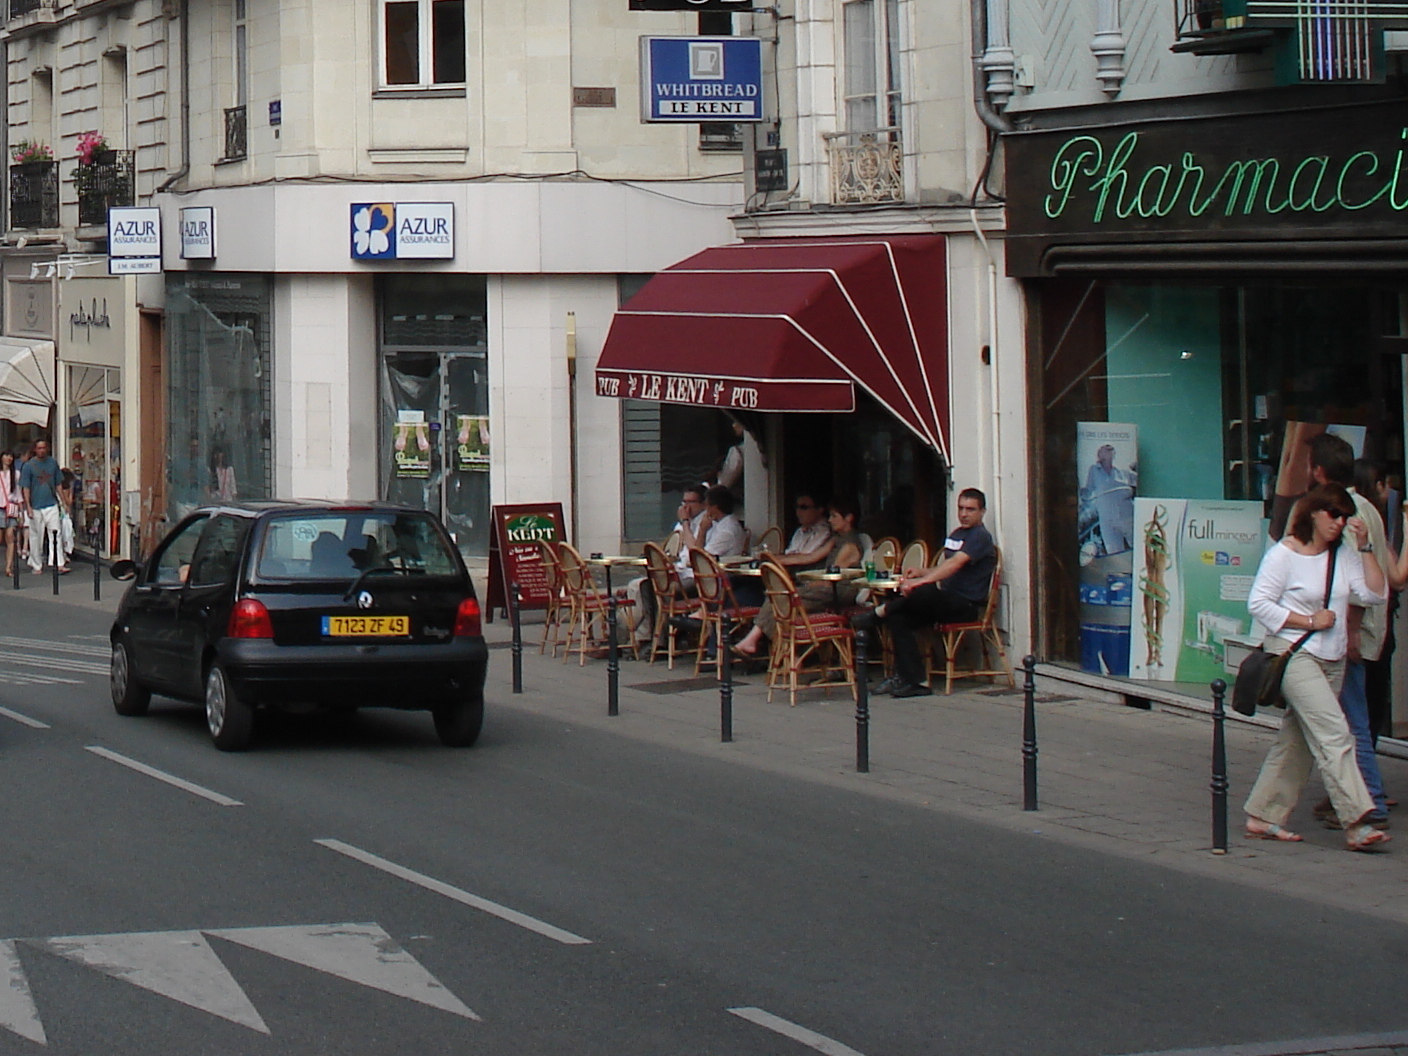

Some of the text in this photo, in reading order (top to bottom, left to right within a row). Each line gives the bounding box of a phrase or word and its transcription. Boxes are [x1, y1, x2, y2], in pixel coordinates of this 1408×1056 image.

[656, 83, 758, 97] WHITBREAD
[696, 102, 744, 113] KENT
[113, 221, 156, 236] AZUR
[184, 221, 209, 236] AZUR
[399, 217, 449, 235] AZUR
[113, 236, 157, 244] ASSURANCES
[399, 235, 450, 244] ASSURANCES
[597, 374, 759, 408] PUB LE KENT PUB
[1187, 518, 1214, 540] full
[334, 618, 404, 633] 7123 ZF 49
